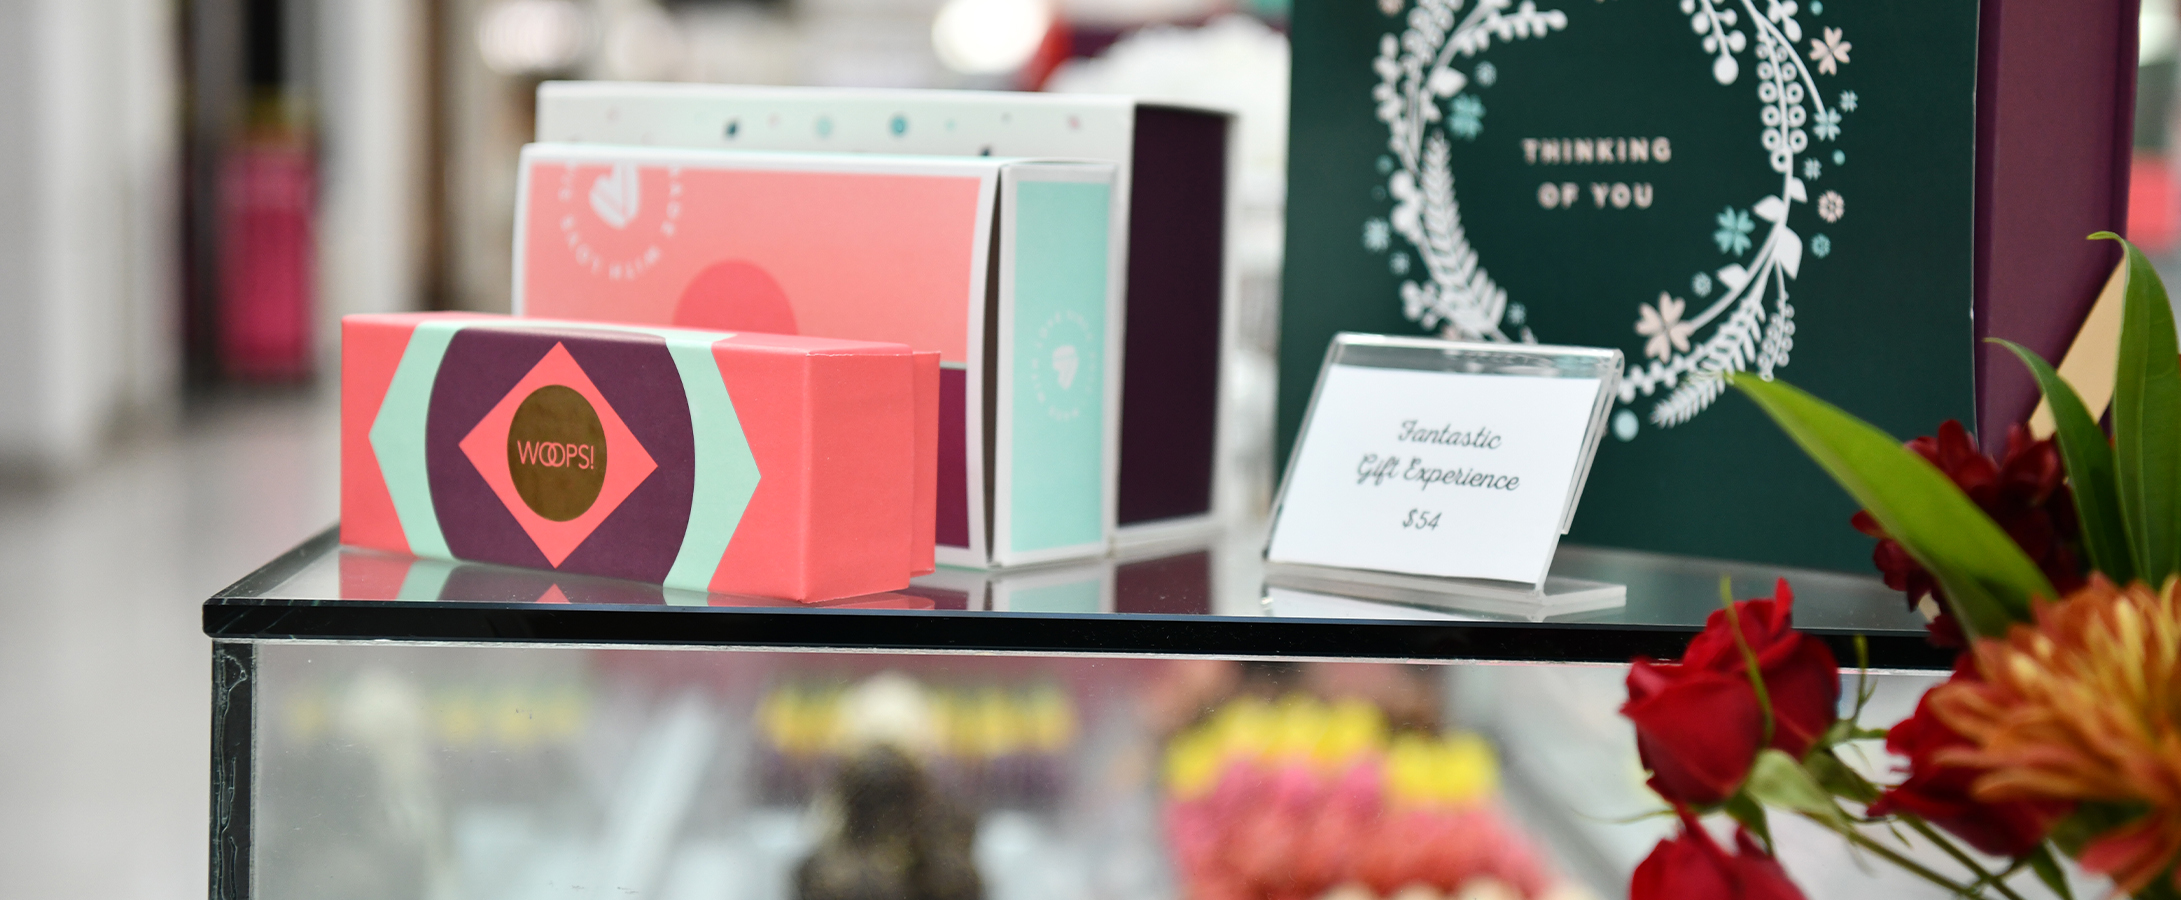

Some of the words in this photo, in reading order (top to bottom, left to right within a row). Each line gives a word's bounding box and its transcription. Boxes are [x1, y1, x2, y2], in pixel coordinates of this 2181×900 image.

[1520, 136, 1672, 165] THINKING
[1537, 181, 1580, 210] OF
[1589, 181, 1654, 210] YOU
[1398, 419, 1503, 450] Fantastic
[517, 440, 595, 470] WOOPS!
[1356, 454, 1401, 486] Gift
[1402, 456, 1521, 491] Experience
[1402, 508, 1442, 531] $54
